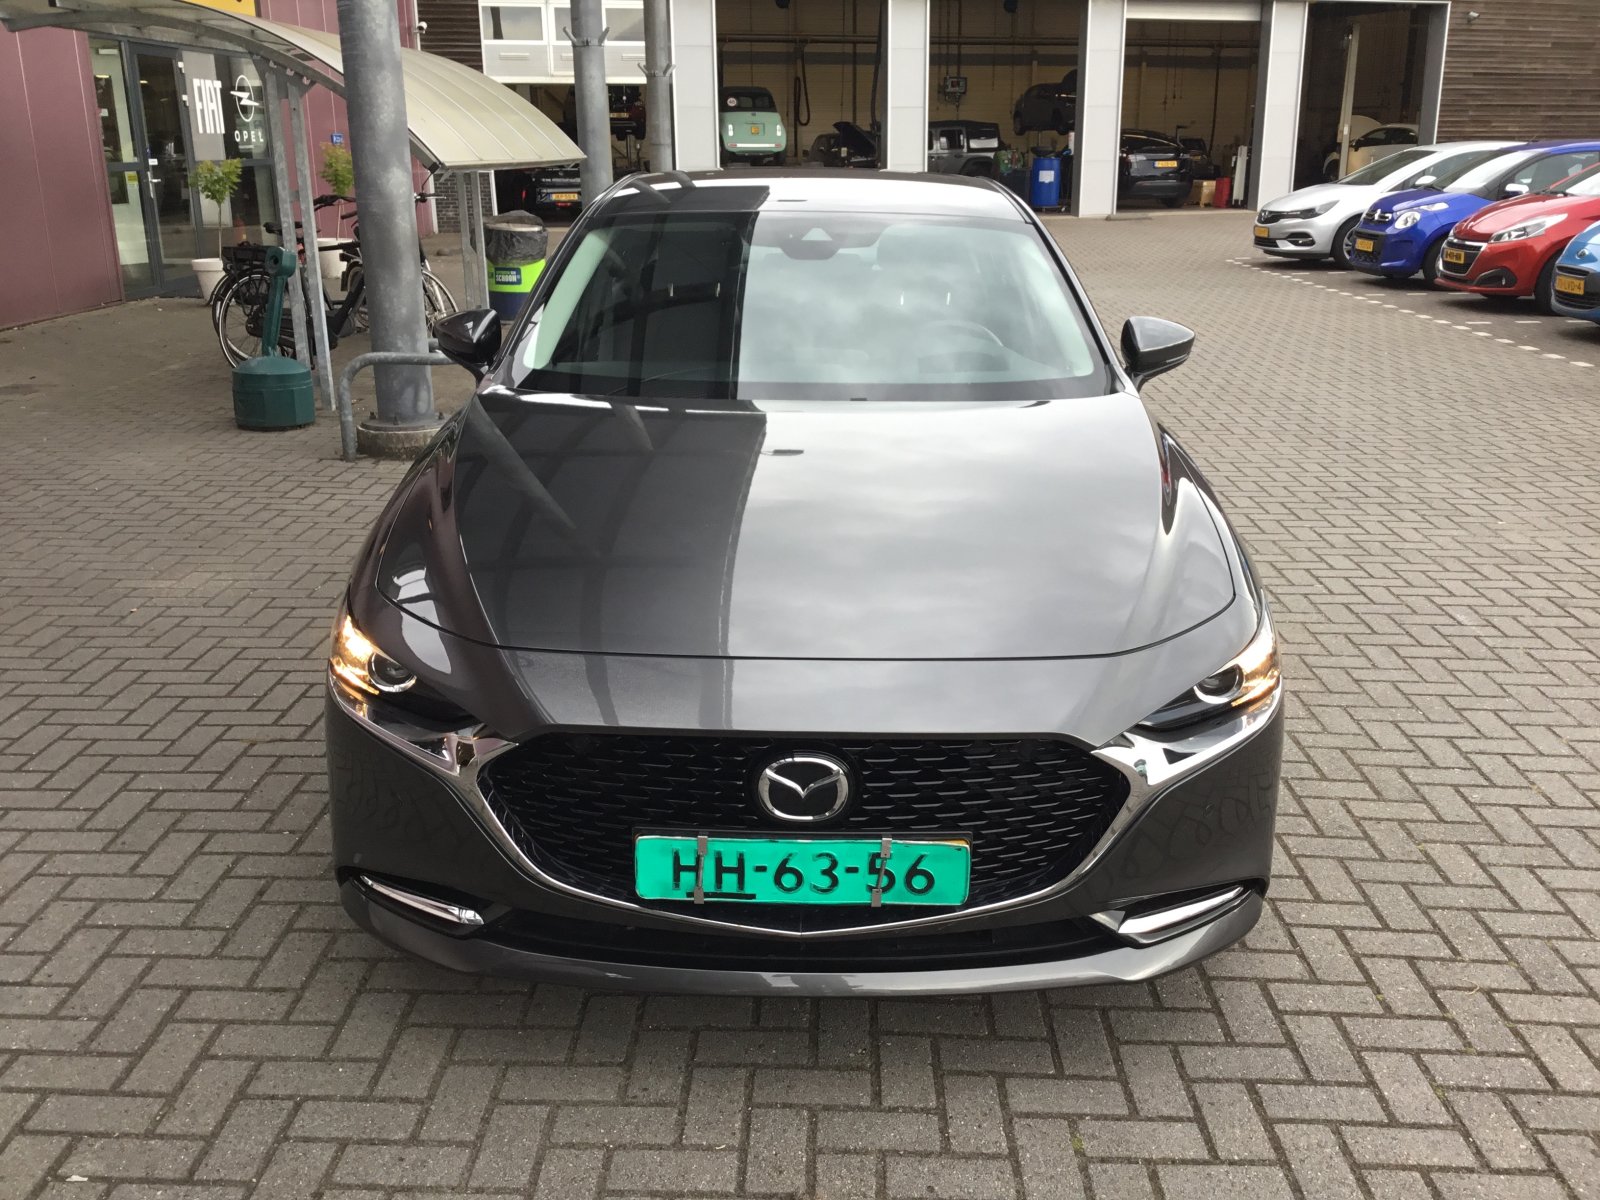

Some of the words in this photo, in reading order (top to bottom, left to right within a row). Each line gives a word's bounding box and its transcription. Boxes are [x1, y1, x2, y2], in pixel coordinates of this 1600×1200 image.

[193, 78, 225, 134] FIAT
[234, 130, 264, 142] OPEL
[671, 849, 936, 895] HH-63-56
